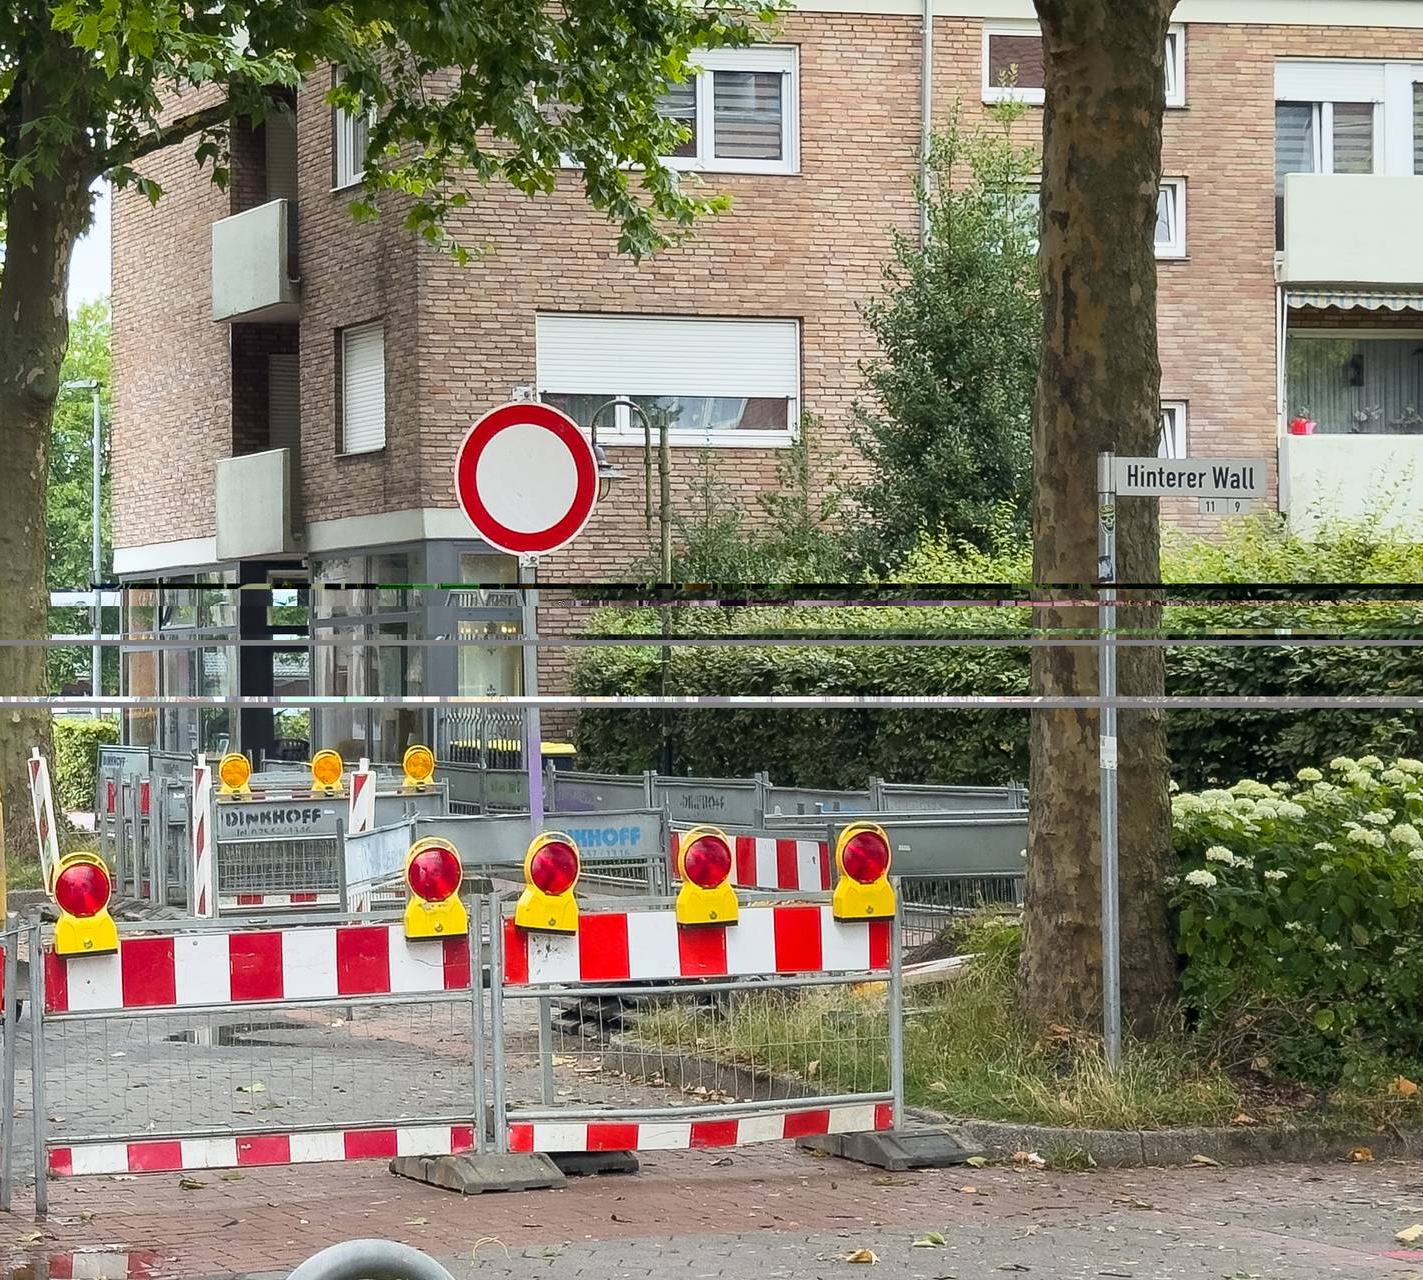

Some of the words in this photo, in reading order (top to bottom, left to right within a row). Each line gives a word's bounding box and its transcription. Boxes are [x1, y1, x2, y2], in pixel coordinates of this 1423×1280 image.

[1127, 464, 1207, 488] Hinterer
[1211, 466, 1255, 490] Wall
[1205, 501, 1216, 513] 11
[1234, 501, 1241, 513] 9
[225, 808, 322, 827] DINKHOFF
[568, 825, 641, 848] KHOFF
